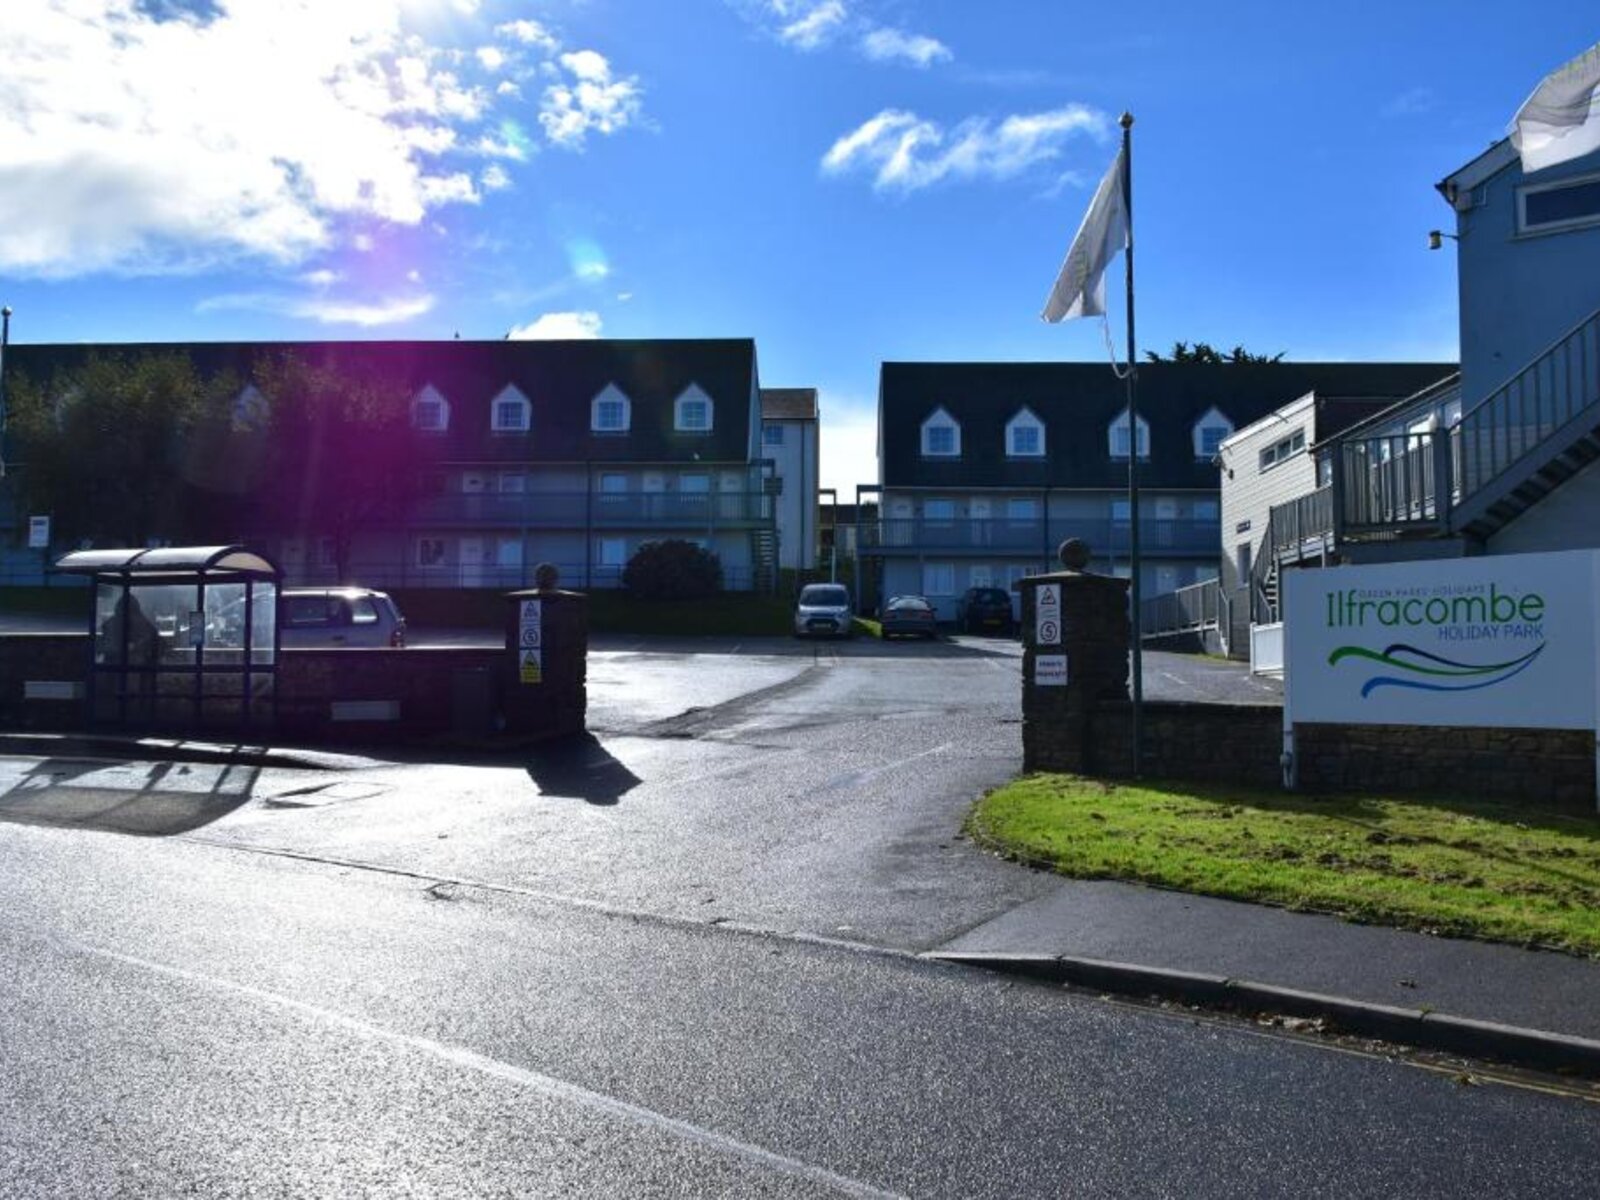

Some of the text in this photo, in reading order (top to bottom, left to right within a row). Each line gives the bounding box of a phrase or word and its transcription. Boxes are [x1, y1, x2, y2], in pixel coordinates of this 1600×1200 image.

[1327, 583, 1545, 627] Ilfracombe
[1438, 624, 1545, 641] HOLIDAY PARK
